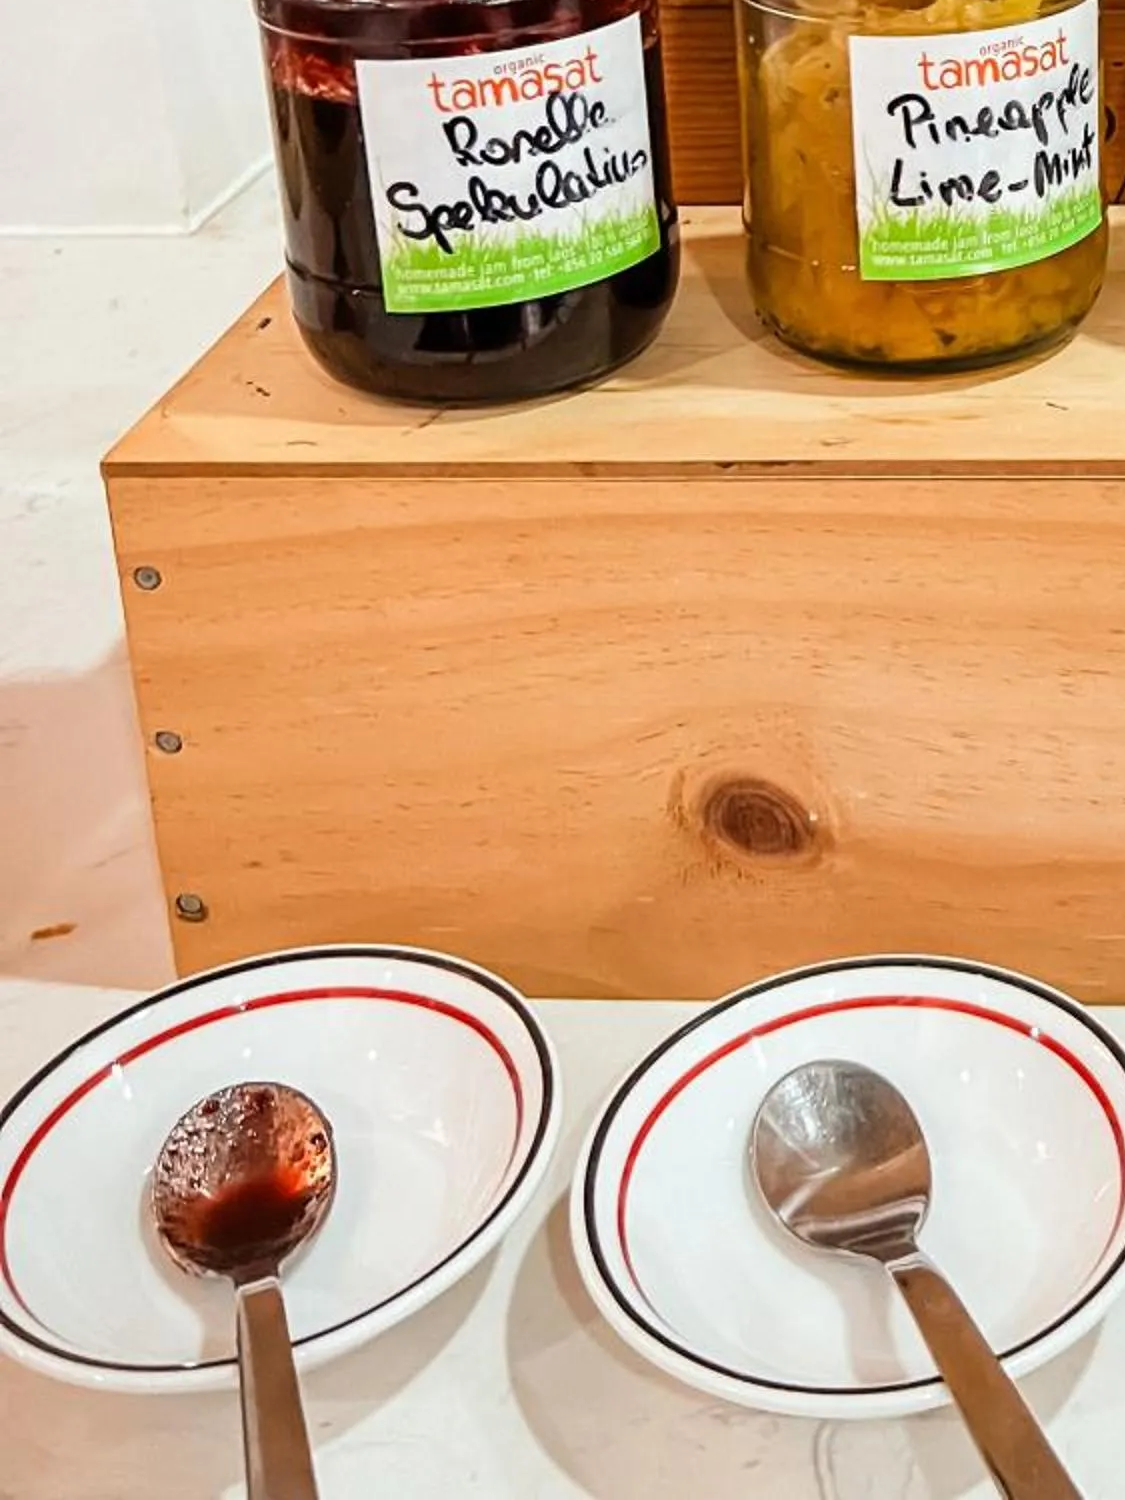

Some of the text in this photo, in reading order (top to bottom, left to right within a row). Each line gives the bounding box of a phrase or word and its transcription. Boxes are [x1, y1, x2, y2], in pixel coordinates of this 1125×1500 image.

[493, 52, 546, 75] organic
[917, 28, 1070, 90] tamasat
[979, 35, 1025, 57] organic
[427, 45, 603, 113] tamasat
[887, 63, 1094, 148] Pineapple
